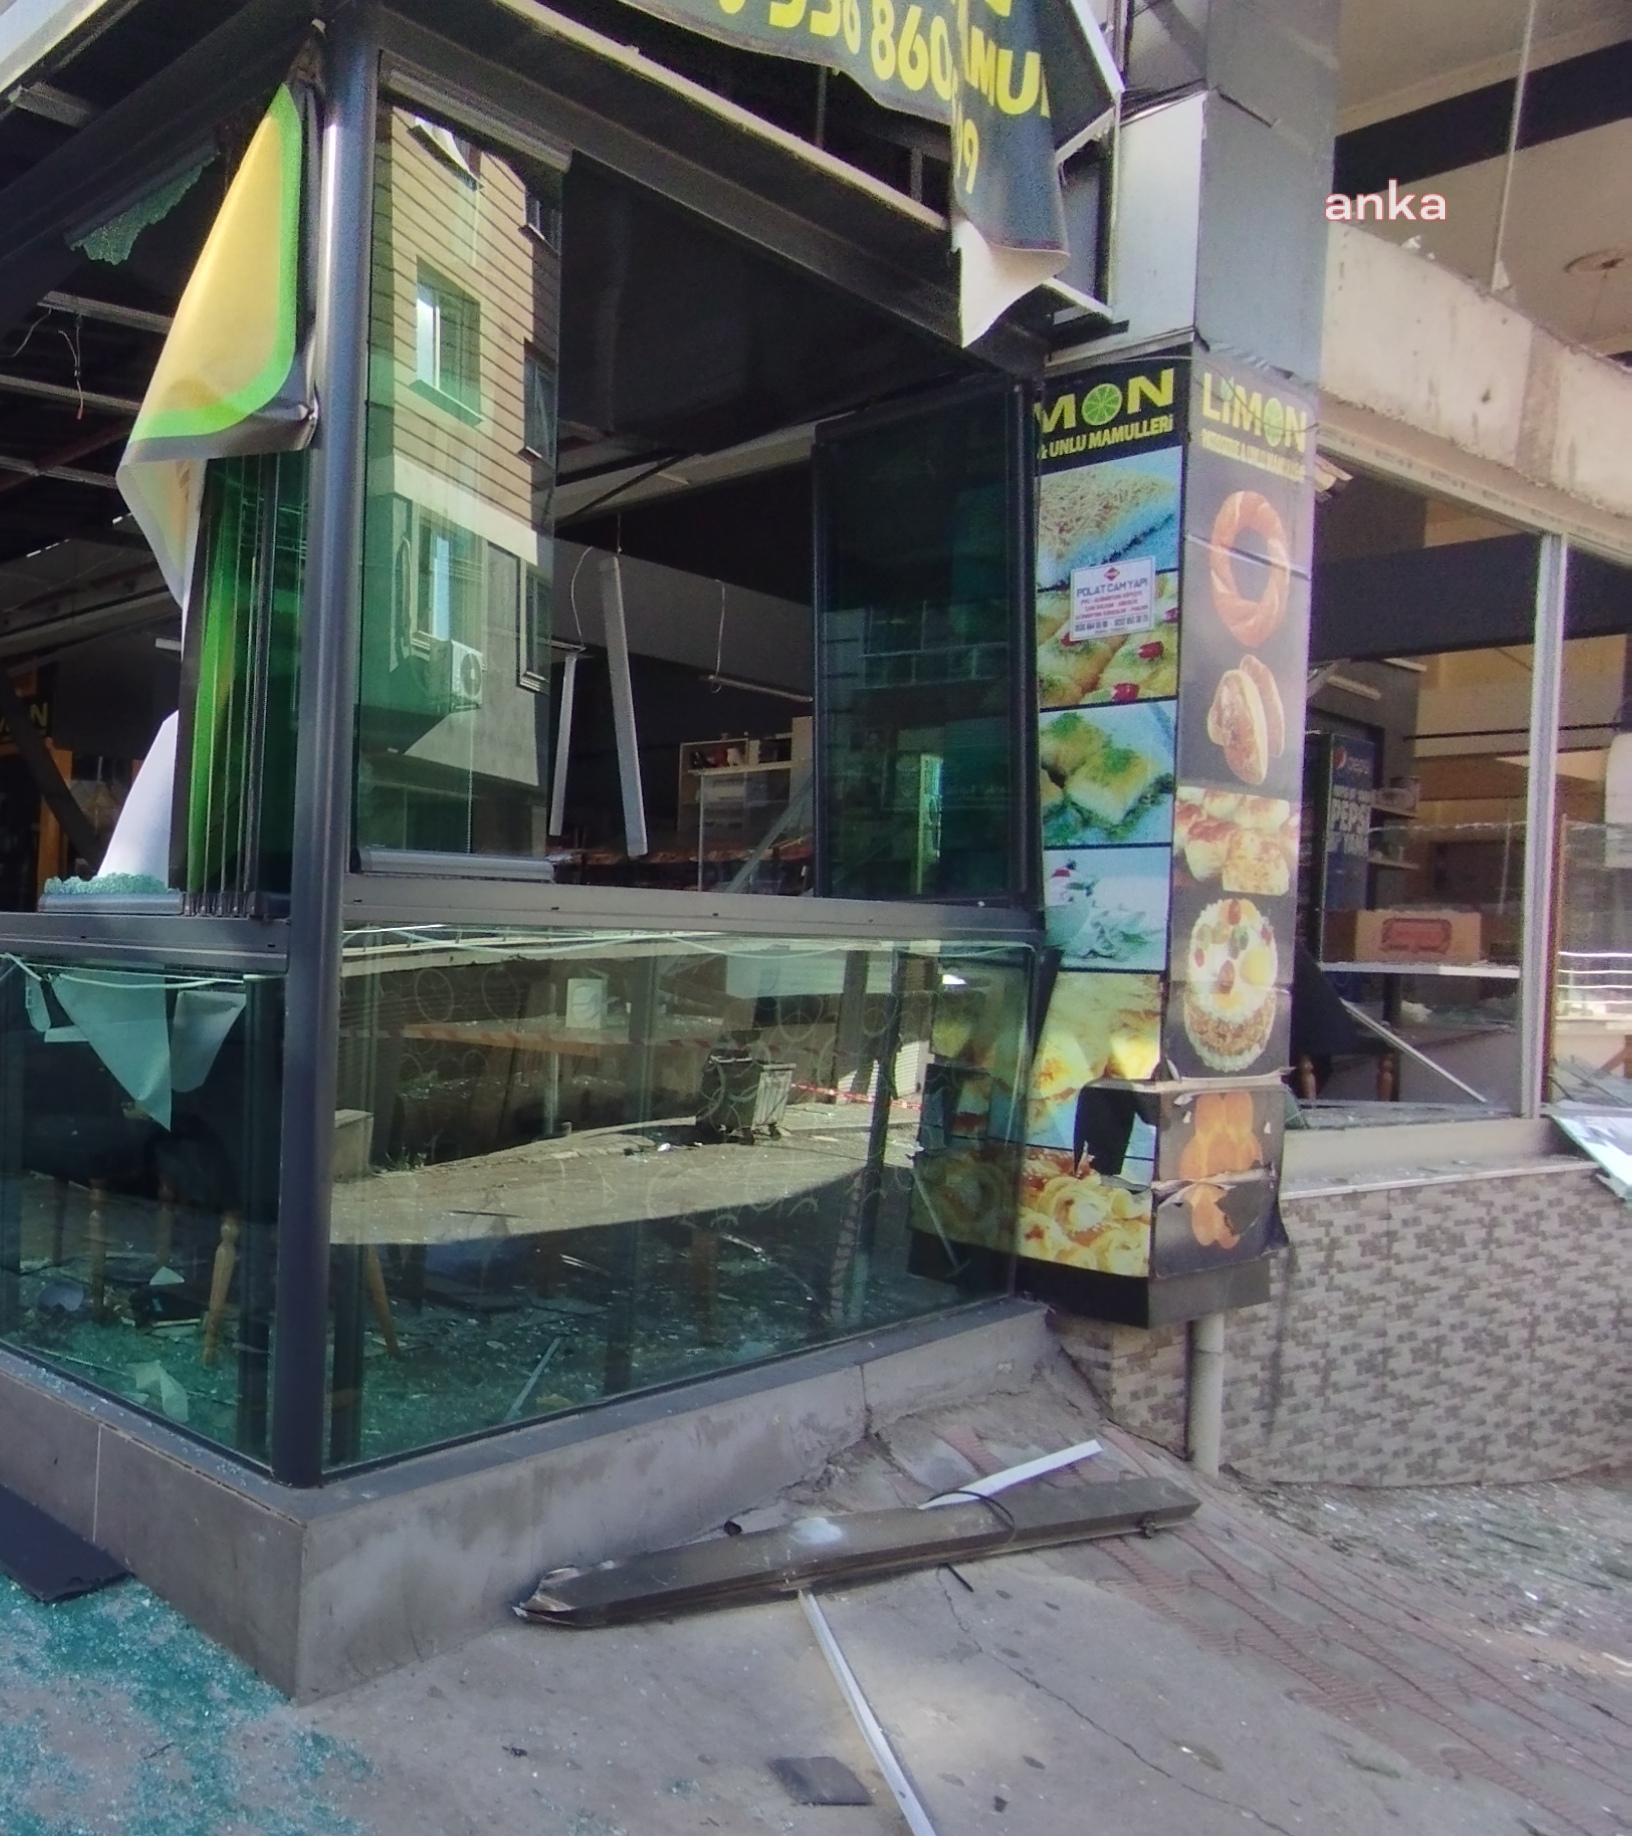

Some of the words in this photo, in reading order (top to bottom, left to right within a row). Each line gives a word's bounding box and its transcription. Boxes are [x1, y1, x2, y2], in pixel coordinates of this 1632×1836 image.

[1049, 434, 1088, 458] UNLU
[1076, 583, 1106, 598] POLAT
[1107, 580, 1127, 592] CAM
